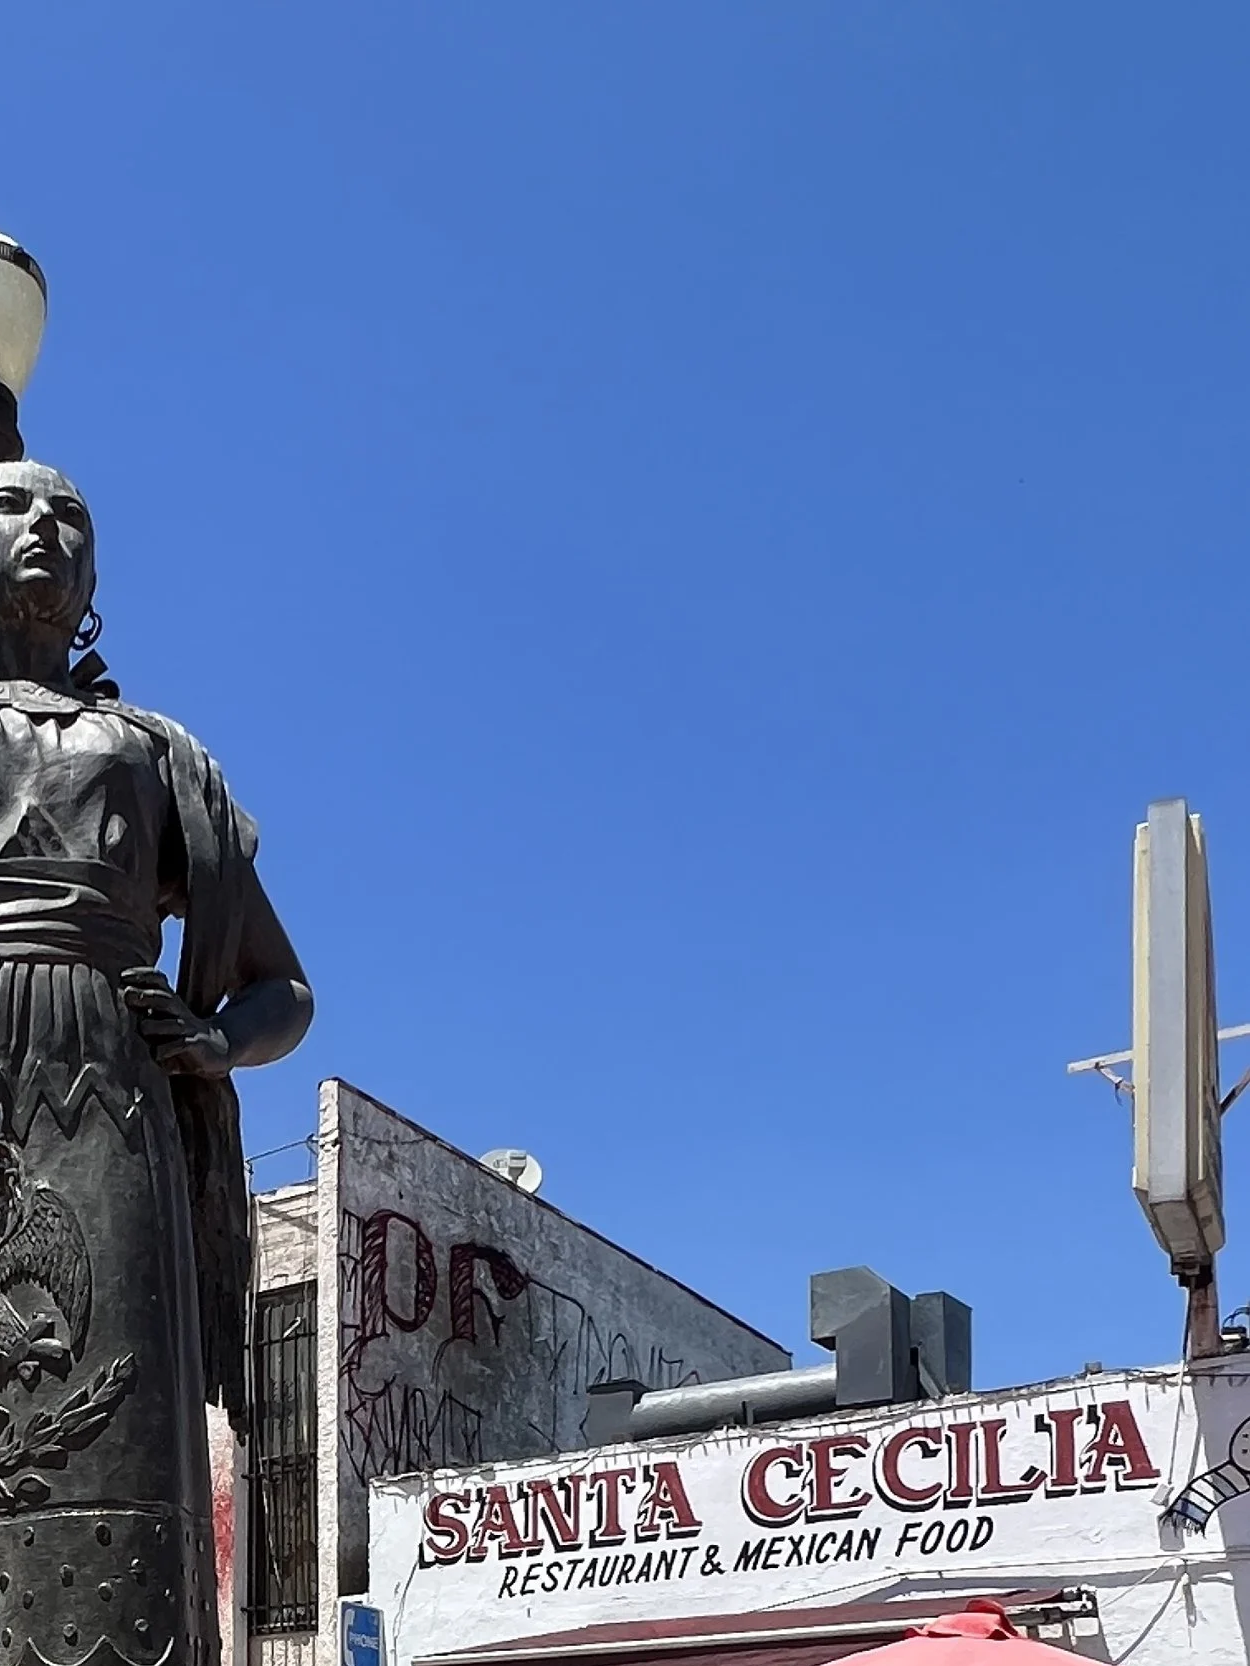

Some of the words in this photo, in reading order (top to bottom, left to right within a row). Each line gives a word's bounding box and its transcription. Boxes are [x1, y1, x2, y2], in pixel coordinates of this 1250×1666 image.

[418, 1461, 702, 1569] SANTA
[742, 1399, 1160, 1526] CECILIA
[499, 1547, 693, 1598] RESTAURANT
[701, 1546, 723, 1575] &
[734, 1528, 880, 1571] MEXICAN
[896, 1517, 993, 1555] FOOD
[349, 1634, 378, 1648] PHONE
